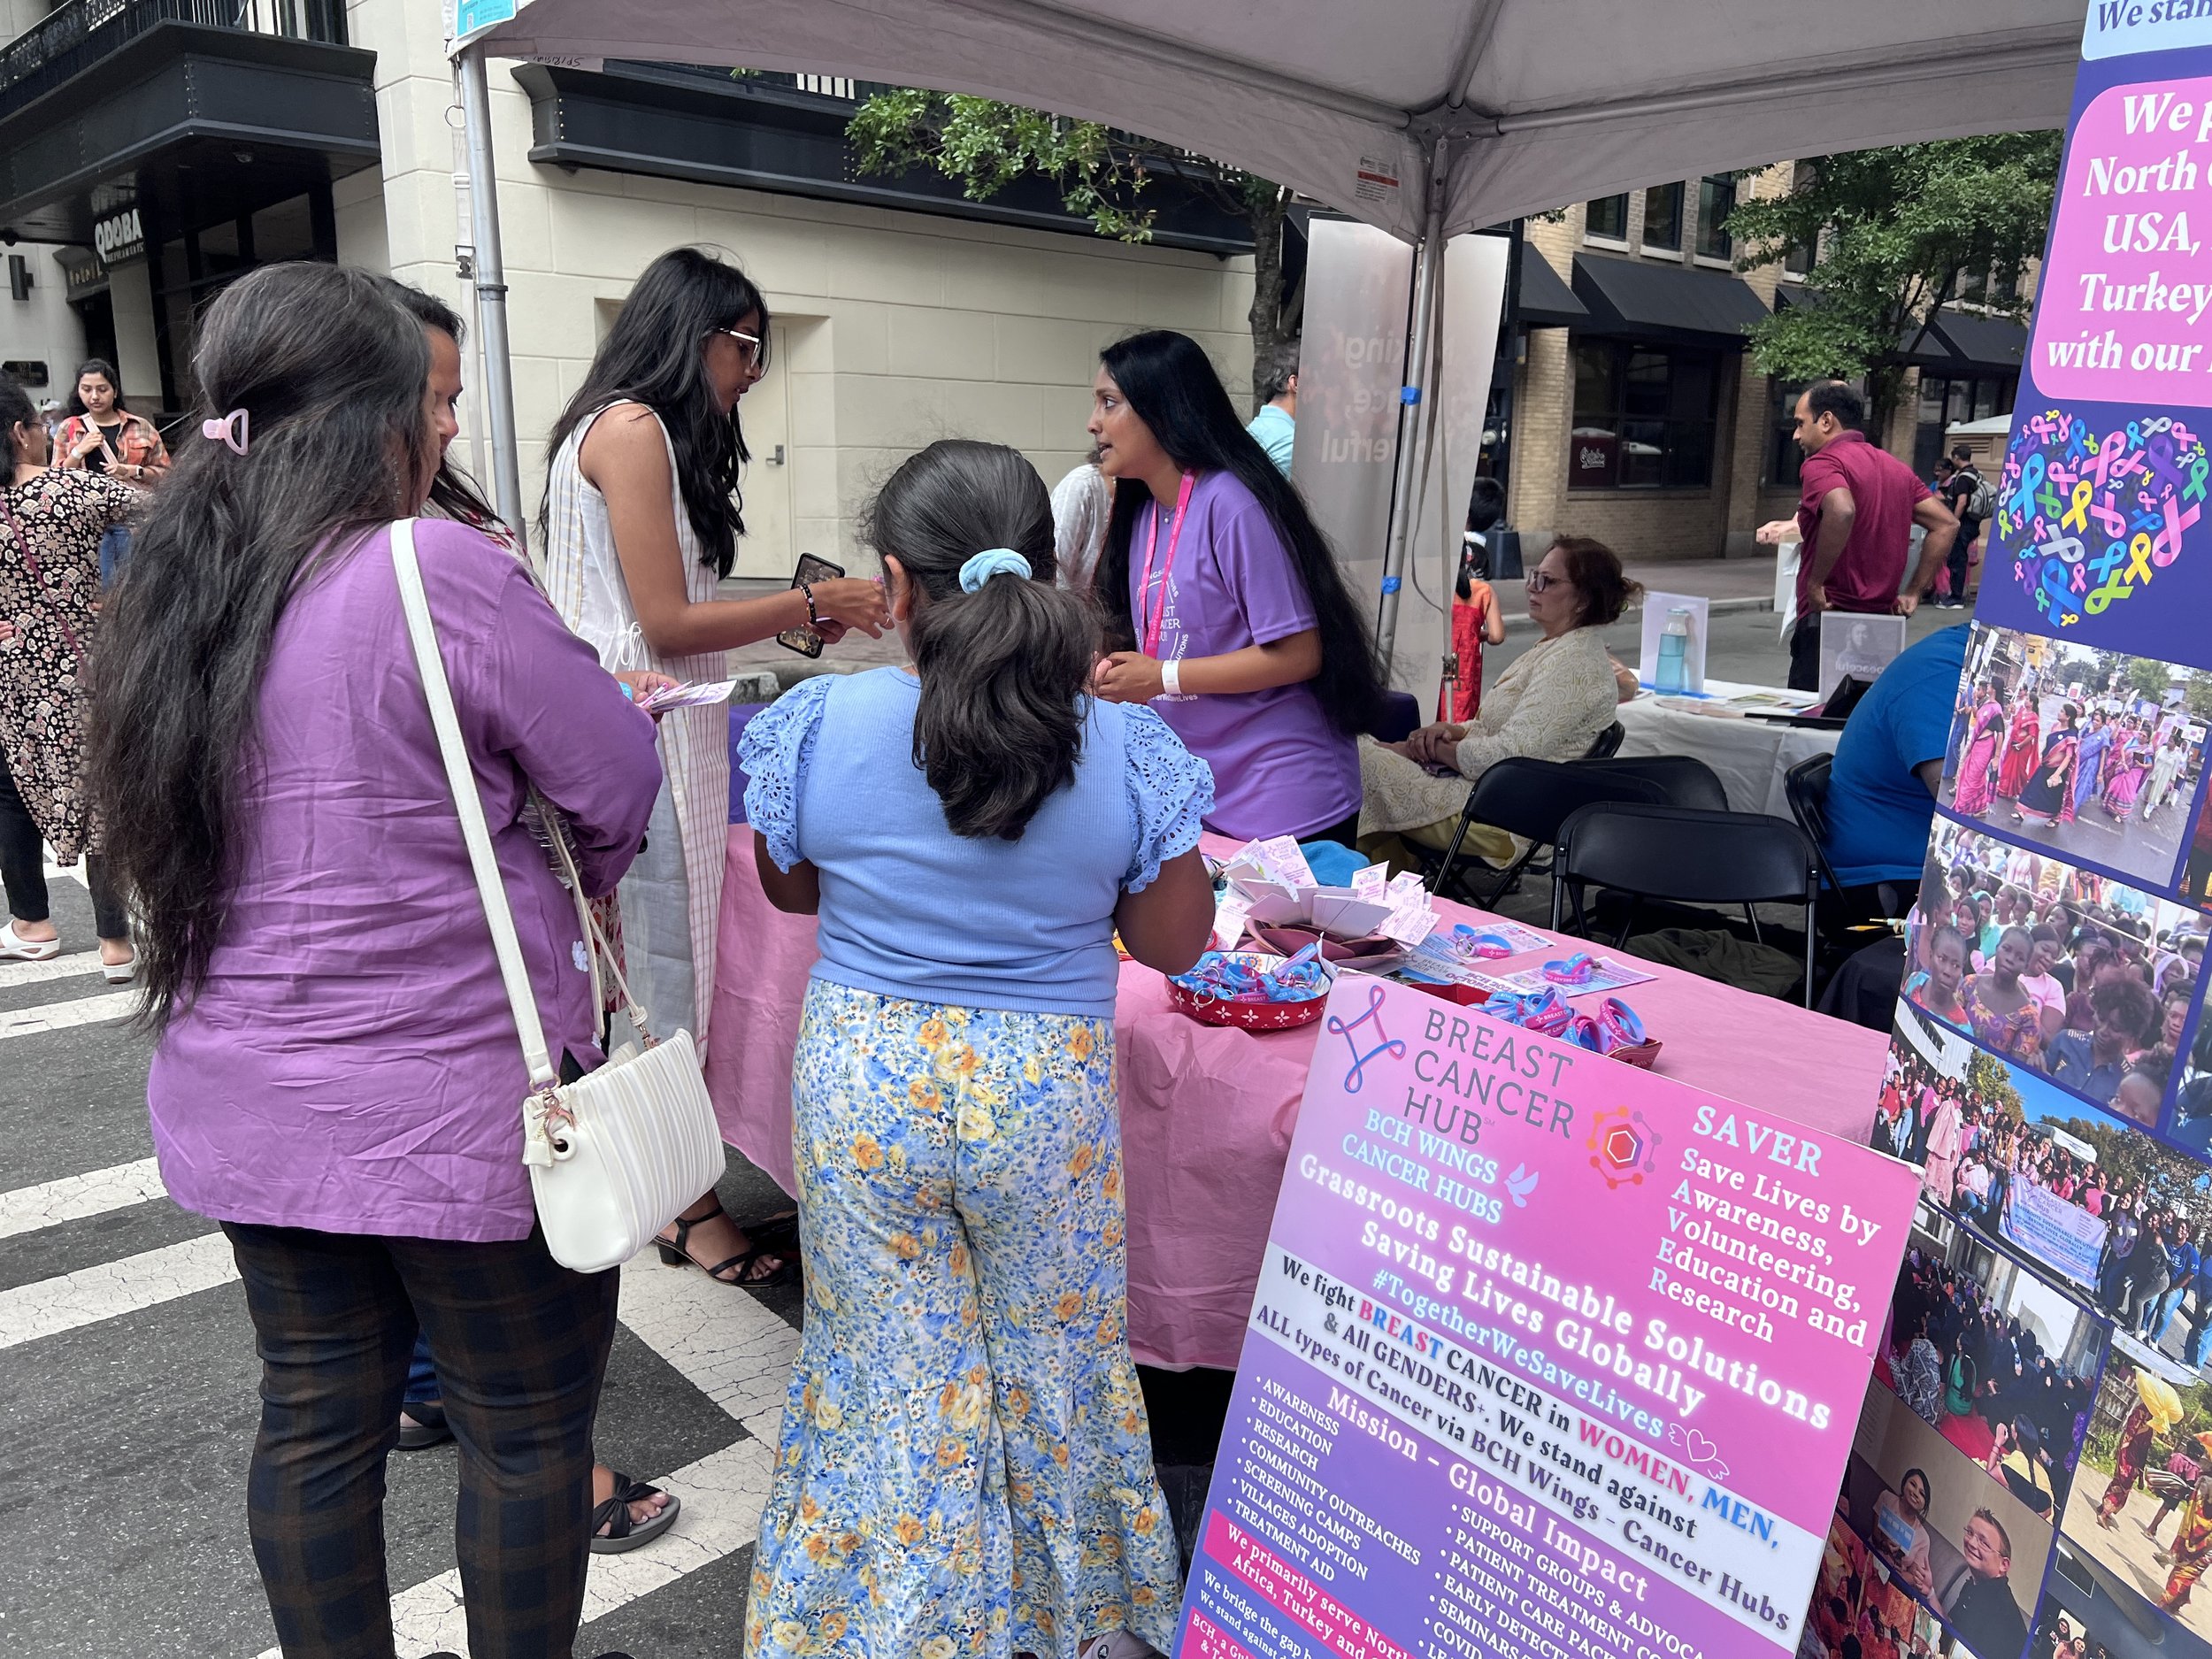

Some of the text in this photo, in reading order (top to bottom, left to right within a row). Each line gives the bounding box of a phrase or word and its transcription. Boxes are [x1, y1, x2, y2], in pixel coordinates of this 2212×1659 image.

[2099, 0, 2143, 32] We
[2124, 92, 2193, 134] We
[2083, 149, 2198, 196] North
[95, 208, 143, 264] QDOBA
[2103, 211, 2201, 257] USA,
[2079, 271, 2212, 326] Turkey
[2047, 330, 2203, 372] with our
[1175, 634, 1189, 661] UTIONS
[1425, 1008, 1574, 1087] BREAST
[1403, 1087, 1483, 1145] HUB
[1414, 1049, 1575, 1140] CANCER
[1341, 1133, 1504, 1225] CANCER HUBS
[1364, 1108, 1498, 1185] BCH WINGS
[1692, 1105, 1823, 1178] SAVER
[1671, 1179, 1833, 1265] Awareness,
[1680, 1148, 1882, 1247] Save Lives by
[1299, 1153, 1832, 1430] Grassroots Sustainable Solutions
[1655, 1236, 1869, 1348] Education and
[1667, 1206, 1861, 1313] Volunteering,
[1361, 1220, 1706, 1417] Saving Lives Globally
[1647, 1267, 1775, 1343] Research
[1372, 1268, 1664, 1438] #TogetherWeSaveLives
[1257, 1397, 1333, 1456] EDUCATION
[1263, 1378, 1340, 1436] AWARENESS
[1282, 1255, 1778, 1549] We fight BREAST CANCER in WOMEN, MEN,
[1324, 1312, 1338, 1335] &
[1341, 1324, 1370, 1354] All
[1499, 1407, 1534, 1447] We
[1540, 1438, 1601, 1485] stand
[1607, 1476, 1698, 1539] against
[1253, 1417, 1319, 1472] RESEARCH
[1256, 1304, 1291, 1338] ALL
[1294, 1324, 1340, 1367] types
[1344, 1360, 1365, 1381] of
[1366, 1369, 1433, 1422] Cancer
[1436, 1413, 1464, 1442] via
[1470, 1434, 1522, 1475] BCH
[1527, 1461, 1600, 1520] Wings
[1623, 1518, 1712, 1586] Cancer
[1718, 1571, 1790, 1632] Hubs
[1239, 1478, 1369, 1581] VILLAGES ADOPTION
[1243, 1459, 1362, 1551] SCREENING CAMPS
[1248, 1439, 1422, 1566] COMMUNITY OUTREACHES
[1326, 1386, 1419, 1462] Mission
[1448, 1462, 1534, 1534] Global
[1543, 1516, 1649, 1602] Impact
[1227, 1522, 1248, 1550] We
[1249, 1544, 1318, 1603] primarily
[1320, 1596, 1362, 1635] serve
[1234, 1499, 1336, 1583] TREATMENT AID
[1460, 1504, 1535, 1563] SUPPORT
[1535, 1552, 1606, 1608] GROUPS
[1609, 1600, 1624, 1619] &
[1192, 1613, 1217, 1645] BCH,
[1220, 1639, 1227, 1650] a
[1200, 1588, 1278, 1659] We stand against
[1203, 1570, 1221, 1594] We
[1222, 1584, 1258, 1623] bridge
[1259, 1617, 1279, 1639] the
[1279, 1634, 1302, 1659] gap
[1232, 1554, 1366, 1659] Africa, Turkey and
[1438, 1597, 1519, 1659] SEMINARS
[1443, 1573, 1495, 1618] EARLY
[1449, 1550, 1518, 1608] PATIENT
[1519, 1599, 1565, 1639] CARE
[1455, 1527, 1525, 1583] PATIENT
[1526, 1572, 1634, 1654] TREATMENT
[1200, 1640, 1210, 1654] &
[1433, 1621, 1483, 1659] COVID
